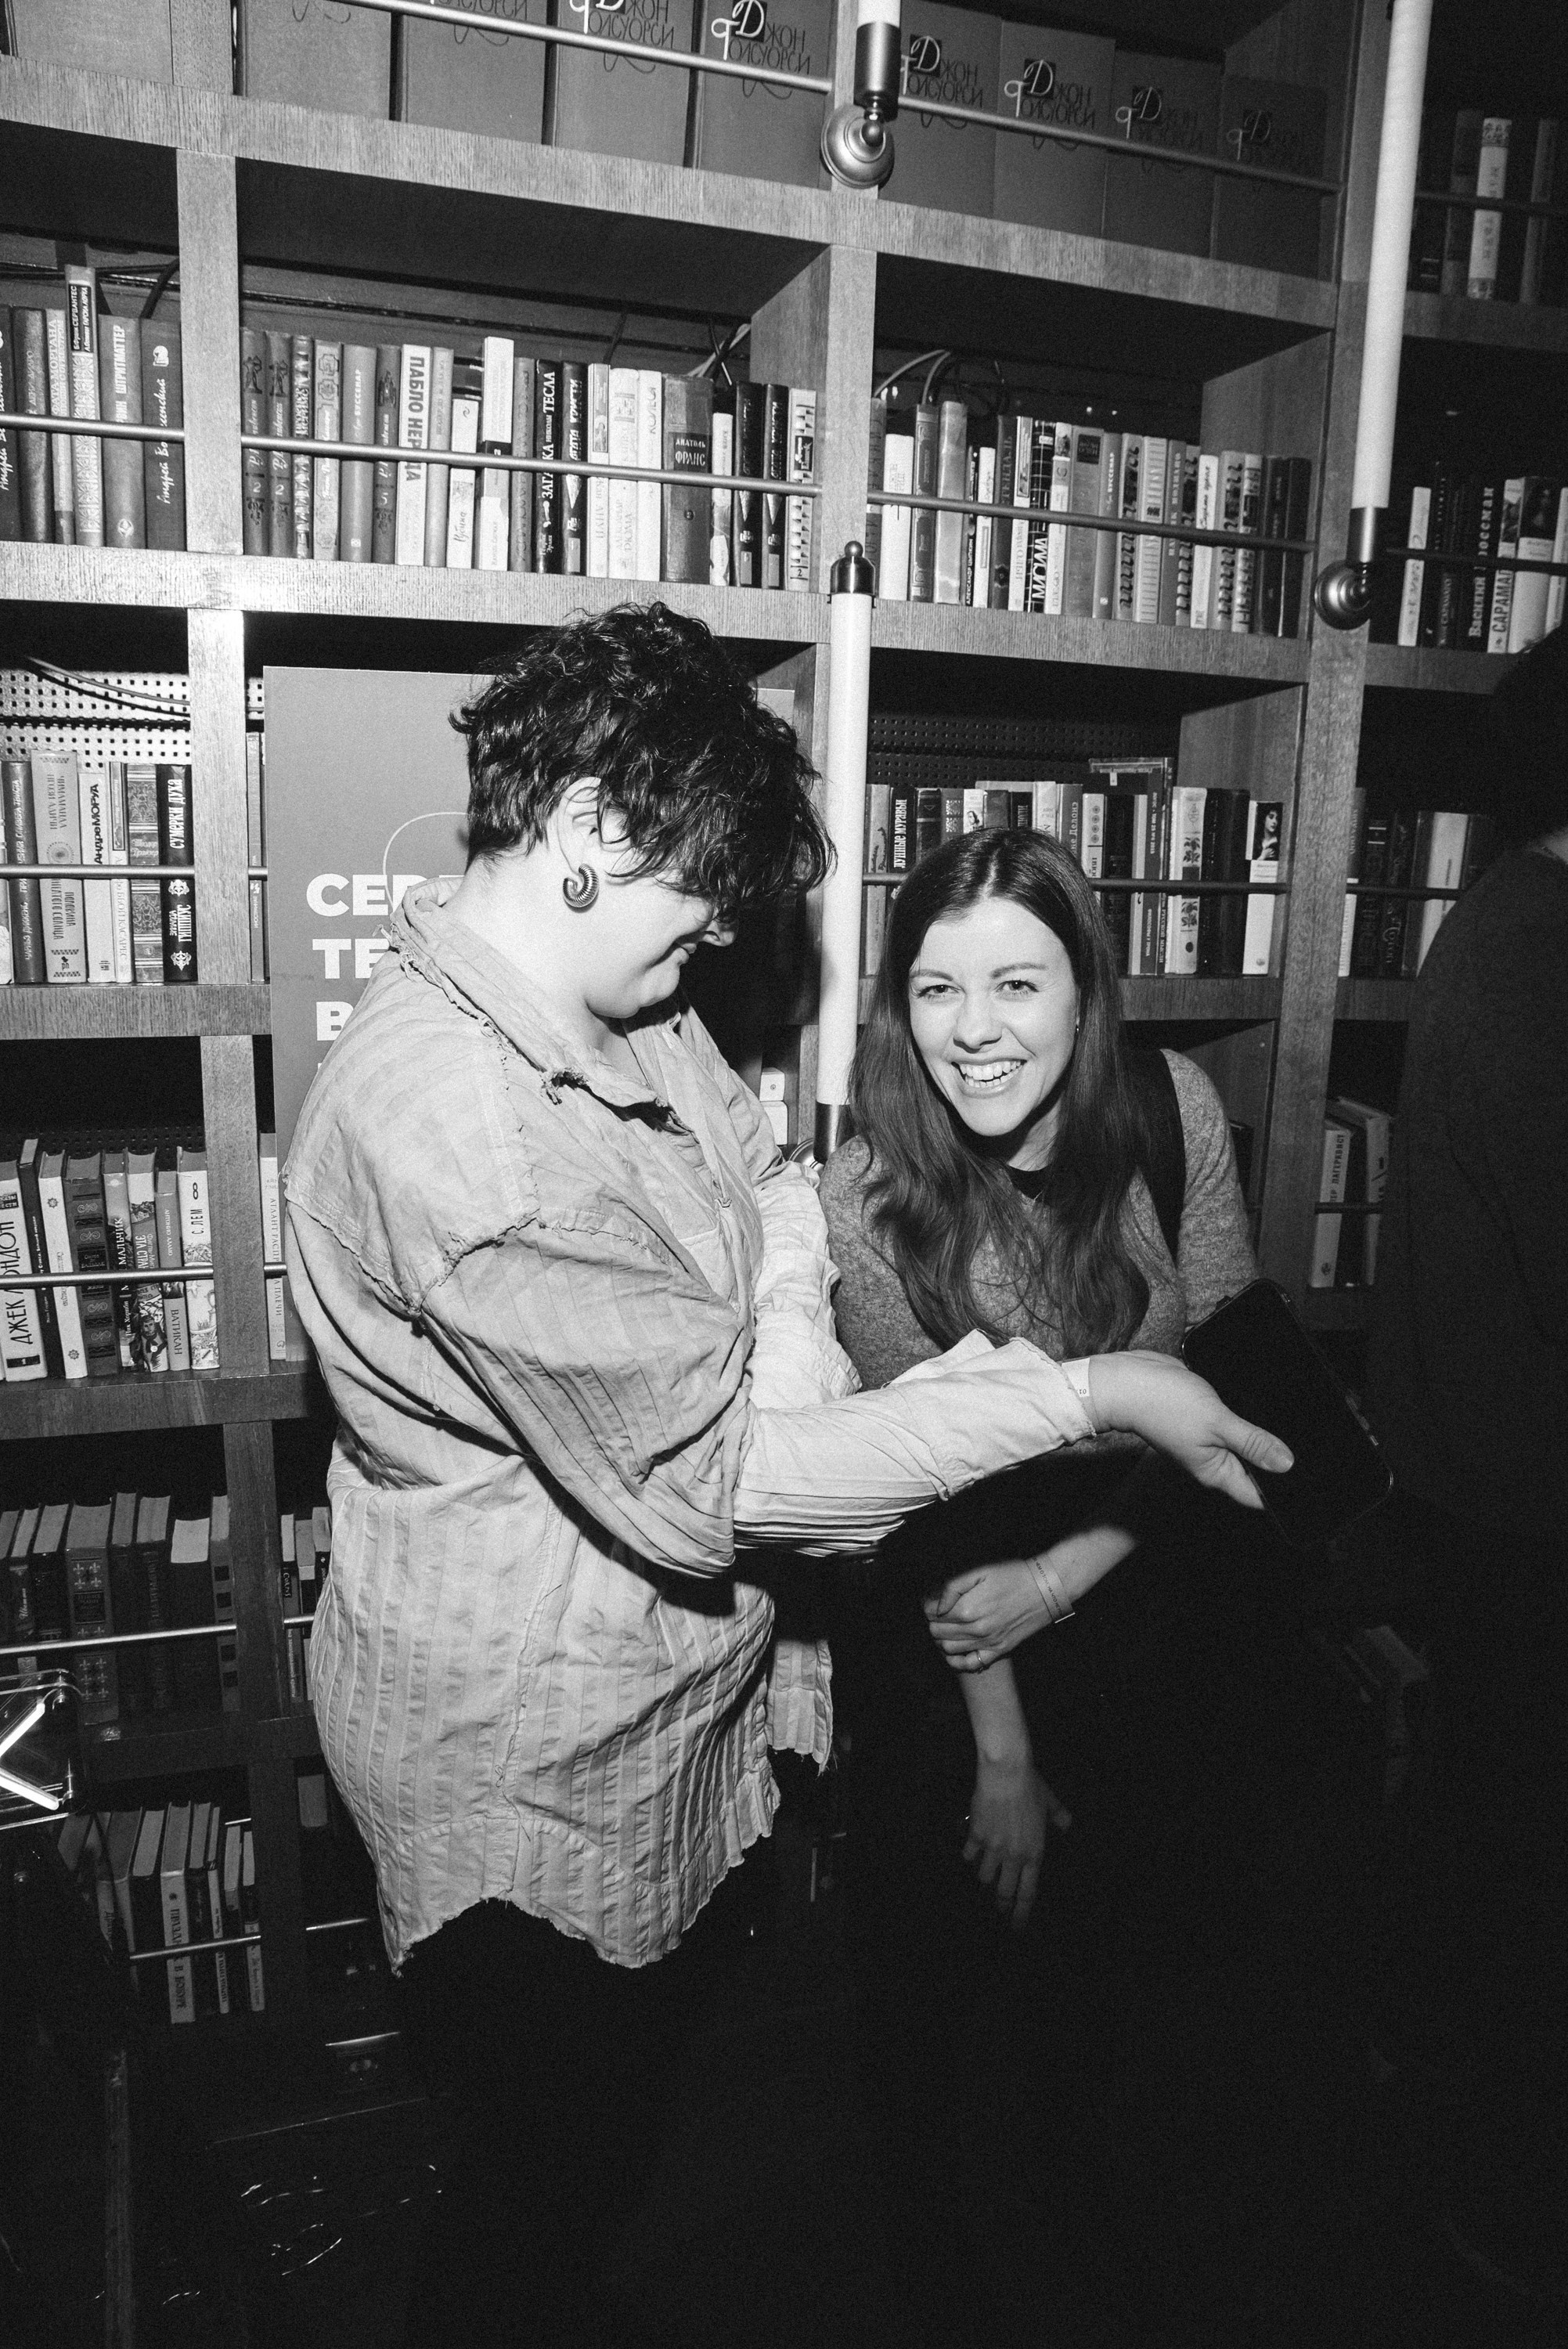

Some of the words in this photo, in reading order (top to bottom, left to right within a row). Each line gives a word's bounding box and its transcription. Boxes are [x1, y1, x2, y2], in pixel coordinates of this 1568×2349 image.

[70, 285, 79, 327] СЕРВАНТЕС
[48, 319, 60, 416] ФАТА-МОРГАНА
[113, 324, 128, 395] ШТРИТМАТТЕР
[354, 369, 362, 417] БУССЕНАР
[408, 356, 425, 413] ПАБЛО
[542, 371, 556, 413] ТЕСЛА
[115, 400, 128, 424] РВИН
[153, 378, 170, 458] Восенский
[646, 387, 657, 435] КОЛЕСА
[405, 417, 424, 482] НЕРДА
[568, 429, 579, 461] АГАТА
[674, 450, 706, 467] ФРАНС
[675, 438, 706, 449] АНАТОЛЬ
[156, 462, 175, 505] Андрей
[541, 443, 555, 500] ЗАГАКА
[452, 511, 470, 543] Рубина
[1473, 487, 1494, 571] оссман
[967, 538, 975, 567] ЦЫПКИН
[965, 567, 974, 605] АЛЕКСАНДР
[1491, 569, 1514, 633] САРАМАГ
[1468, 576, 1487, 637] Василий
[11, 779, 21, 806] ТВИСТА
[47, 774, 59, 800] НГОЗИ
[57, 775, 68, 829] ЧИМАМАНДА
[168, 778, 186, 805] ДУХА
[13, 806, 24, 838] ОЛИВЕРА
[47, 801, 58, 830] АДИЧИ
[168, 806, 186, 850] СУМЕРКИ
[894, 798, 908, 835] МУРАВЬИ
[1068, 801, 1080, 836] Делонэ
[92, 826, 103, 864] Андре
[893, 835, 907, 870] ЛУННЫЕ
[15, 840, 28, 893] ПРИЧЕНИЯ
[64, 891, 77, 927] ПОЛОВИНА
[306, 873, 466, 917] СЕР
[20, 901, 31, 933] ДИККЕНС
[52, 911, 64, 940] СОЛНЦА
[168, 910, 178, 936] ЗИНАИДА
[176, 904, 193, 943] ГИППИУС
[1159, 908, 1168, 938] РУССКОЙ
[23, 934, 33, 960] ЧАРЛЬЗ
[189, 1208, 204, 1226] ЛЕМ
[269, 1197, 279, 1232] АТЛАНТ
[114, 1217, 128, 1265] МАЛЬЧИК
[135, 1235, 148, 1250] ЭТА
[146, 1233, 157, 1269] Фигль-Миг
[271, 1233, 282, 1285] РАСПРЛ
[136, 1250, 149, 1269] СТРАН
[123, 1301, 132, 1323] Хорнби
[274, 1286, 283, 1317] ПЛЕЧИ
[5, 1299, 33, 1345] ДЖЕК
[170, 1308, 183, 1355] ВАТИКАН
